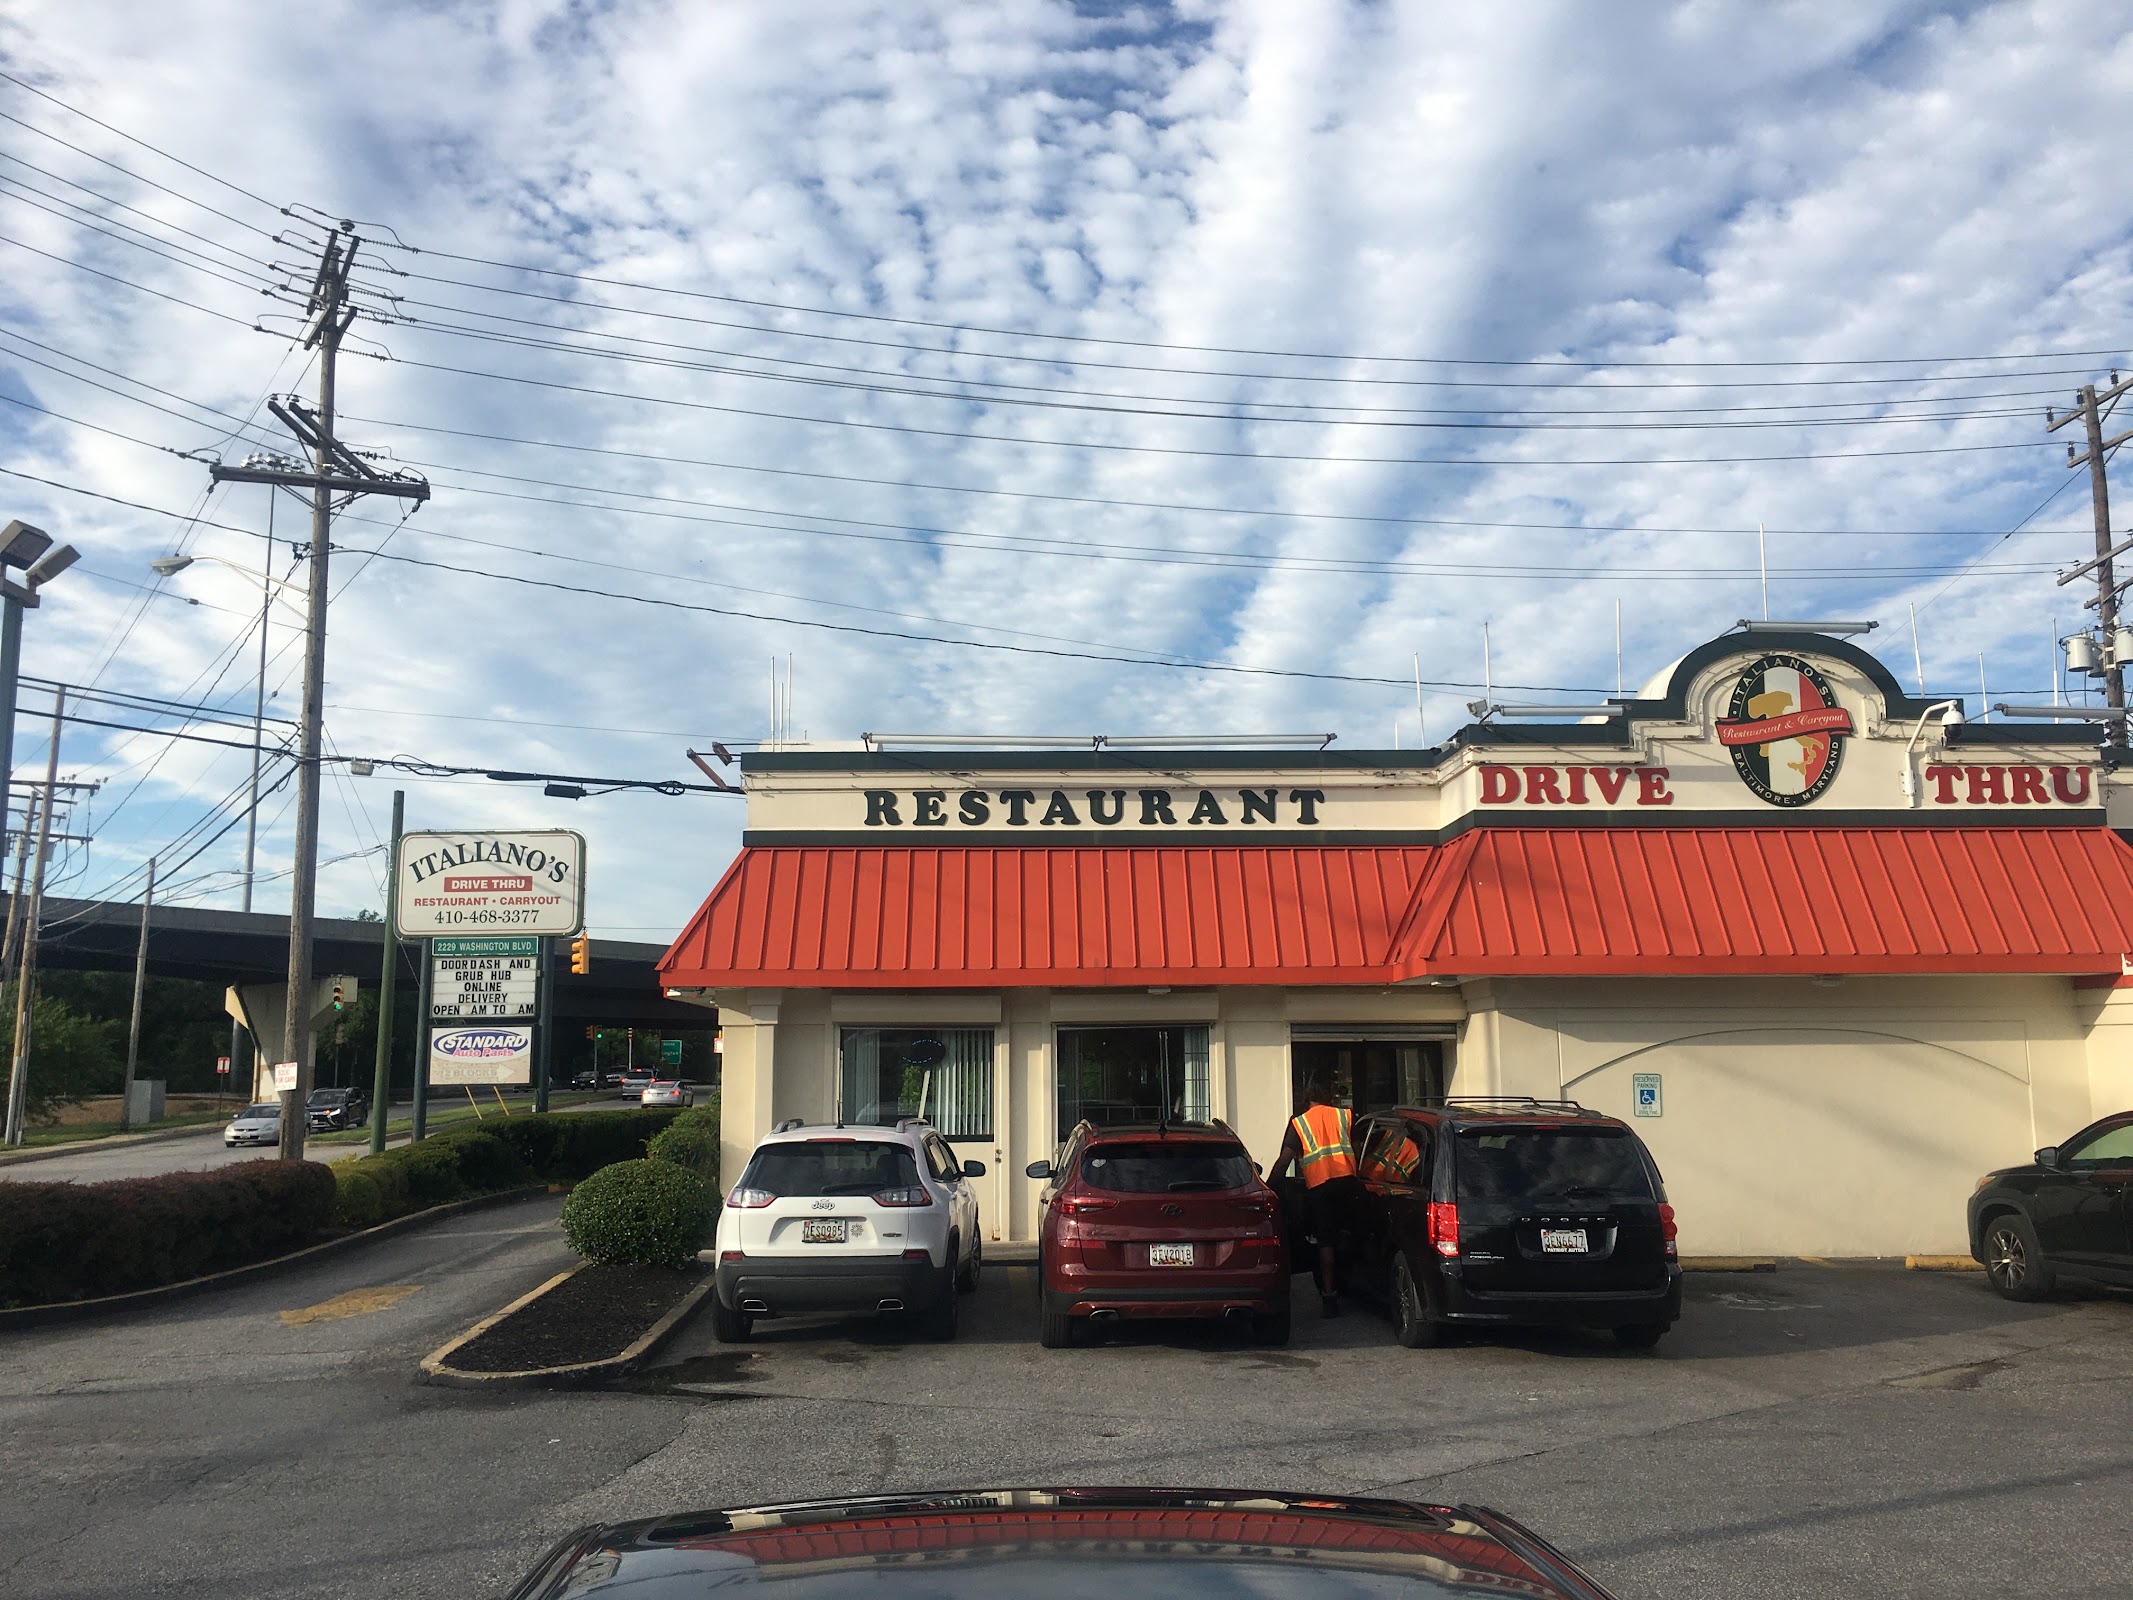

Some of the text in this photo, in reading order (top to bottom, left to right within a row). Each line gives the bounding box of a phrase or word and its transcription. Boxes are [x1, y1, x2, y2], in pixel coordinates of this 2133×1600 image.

[1732, 657, 1829, 705] ITALIANO'S
[1723, 714, 1844, 739] Restaurant & Carryout
[1734, 741, 1839, 804] BALTIMORE, MARYLAND
[1479, 766, 2092, 805] DRIVE THRU
[864, 788, 1325, 826] RESTAURANT
[408, 840, 570, 883] ITALIANO'S
[451, 878, 526, 890] DRIVE THRU
[414, 896, 561, 907] RESTAURANT CARRYOUT
[434, 909, 540, 924] 410-468-3377
[437, 941, 534, 951] 2229 WASHINGTON BLVD.
[441, 959, 531, 970] DOORDASH AND
[455, 970, 512, 981] GRUB HUB
[464, 982, 502, 992] ONLINE
[458, 993, 508, 1004] DELIVERY
[433, 1004, 534, 1015] OPEN AM TO AM
[446, 1033, 527, 1050] STANDARD
[453, 1047, 514, 1057] Auto Parts
[811, 1202, 836, 1211] Jeep
